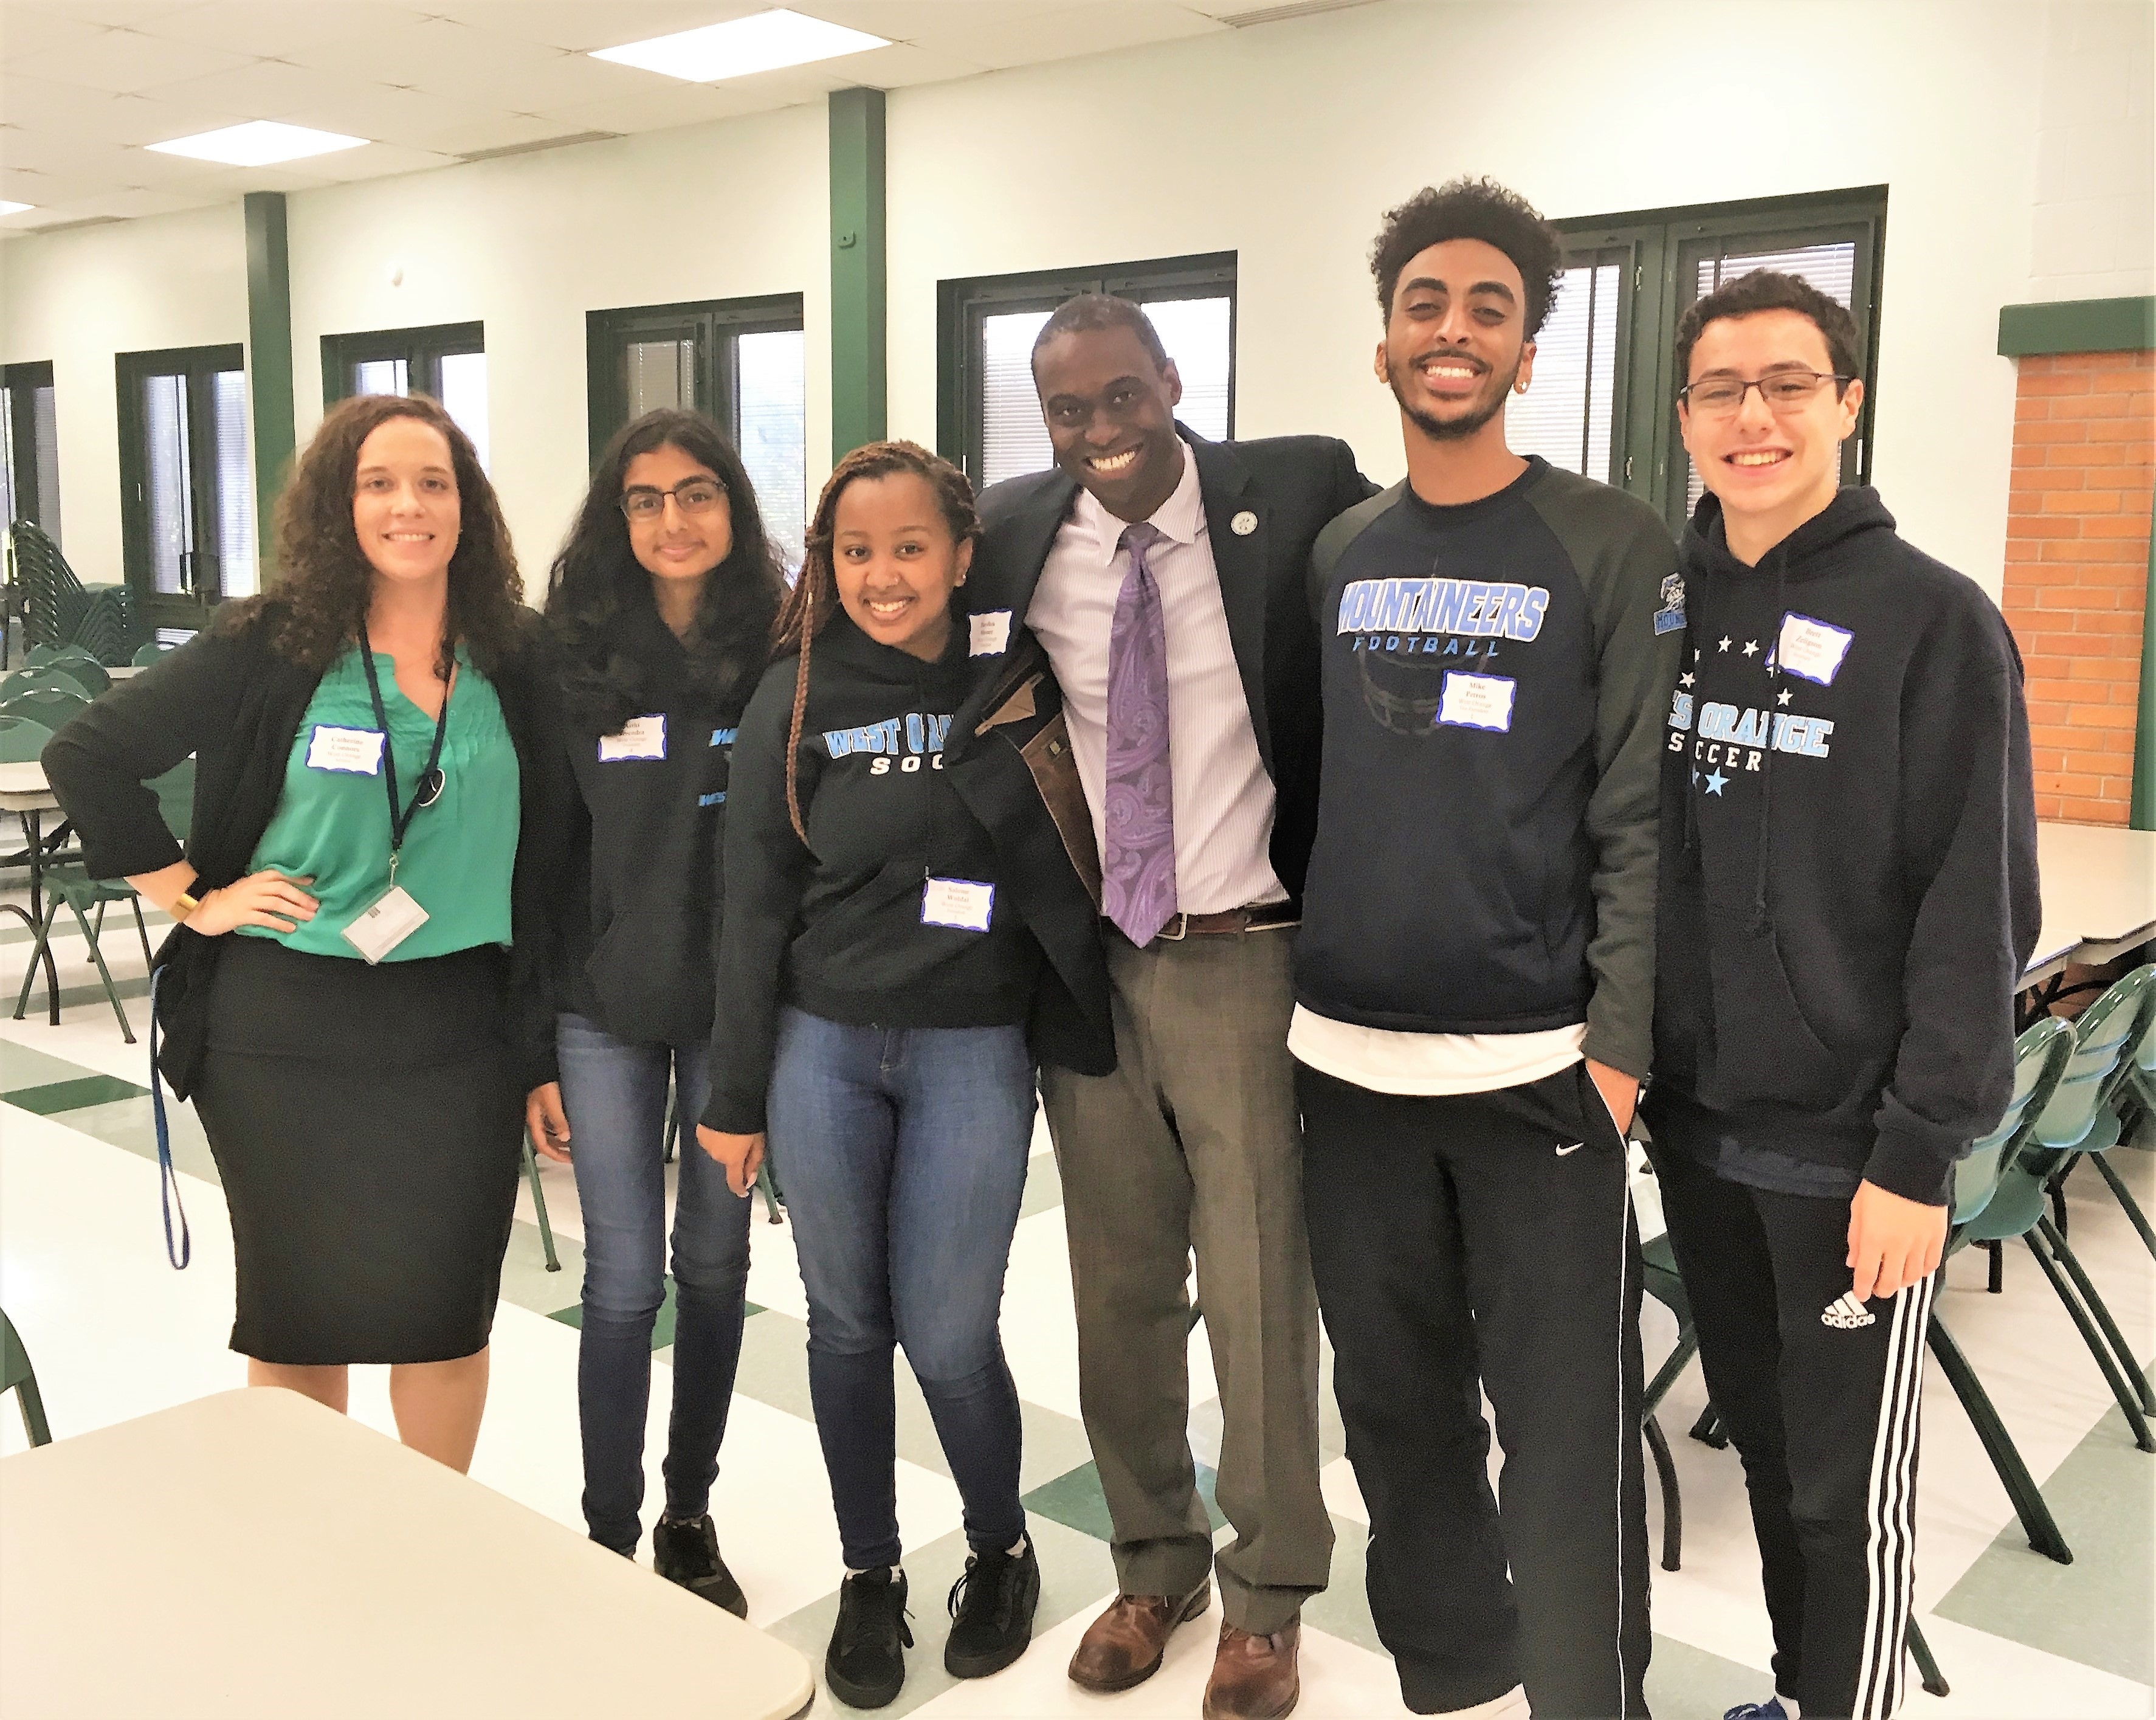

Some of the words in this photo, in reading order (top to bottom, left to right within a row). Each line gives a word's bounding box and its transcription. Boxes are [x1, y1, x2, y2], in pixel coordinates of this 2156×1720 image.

[1337, 577, 1551, 642] MOUNTAINEERS
[1352, 636, 1499, 657] FOOTBALL
[1466, 691, 1486, 699] Petros
[822, 717, 901, 759] WEST
[1698, 702, 1834, 758] ORANGE
[1821, 1313, 1876, 1329] adidas
